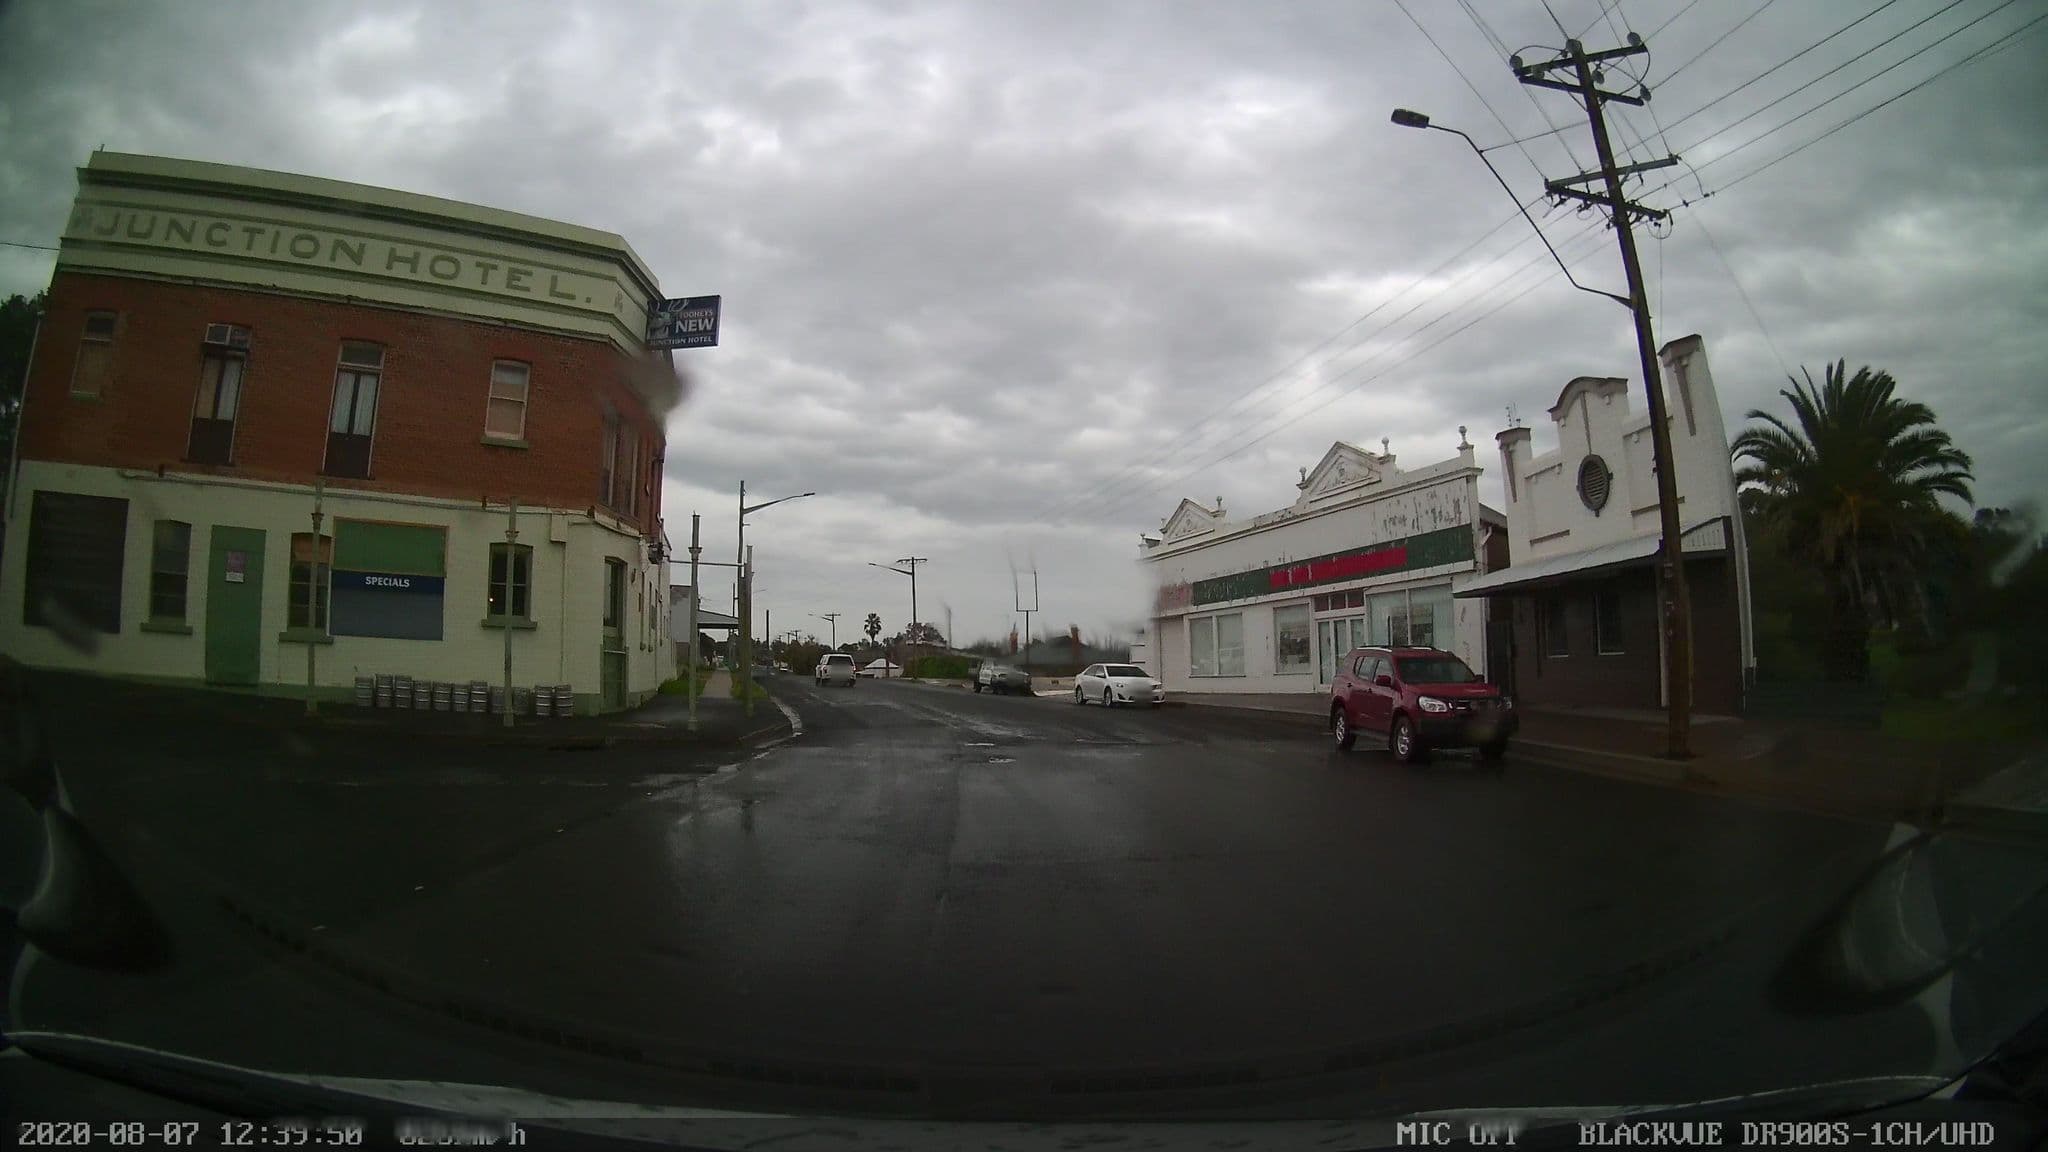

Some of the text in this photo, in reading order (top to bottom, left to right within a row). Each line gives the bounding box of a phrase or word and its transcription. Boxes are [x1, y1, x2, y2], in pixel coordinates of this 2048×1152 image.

[94, 212, 366, 266] JUNCTION
[675, 318, 714, 333] NEW
[687, 335, 712, 344] HOTEL
[365, 576, 410, 587] SPECIALS
